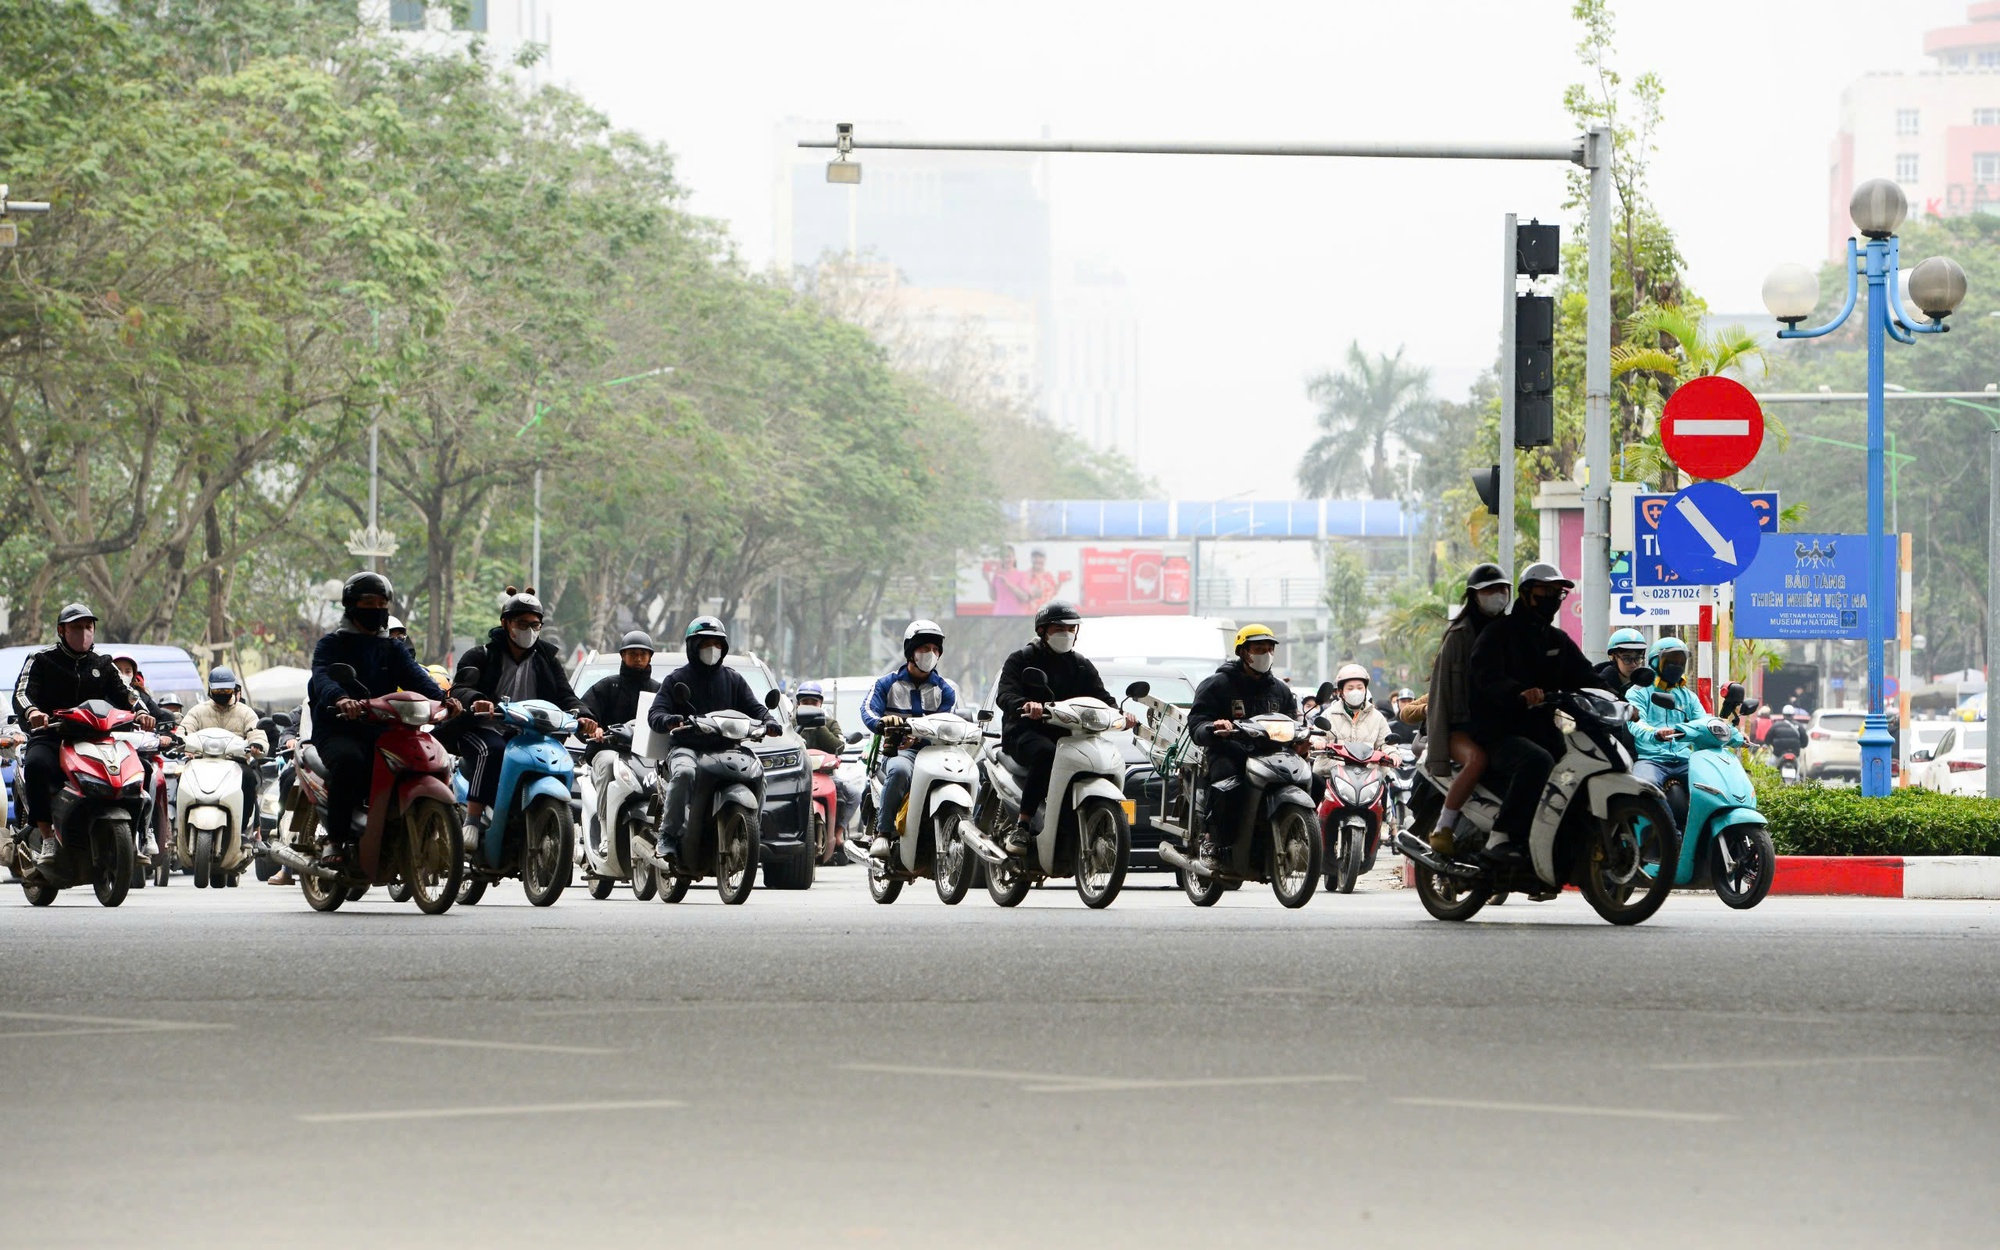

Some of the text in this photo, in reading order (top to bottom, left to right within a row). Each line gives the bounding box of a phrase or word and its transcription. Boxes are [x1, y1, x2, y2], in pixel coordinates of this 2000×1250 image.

[1785, 570, 1846, 589] BẢO TÀNG
[1653, 588, 1670, 599] 028
[1672, 588, 1694, 598] 7102
[1750, 590, 1868, 610] THIÊN NHIÊN VIỆT NA
[1650, 608, 1670, 616] 200m
[1770, 618, 1801, 626] MUSEUM
[1808, 618, 1839, 626] NATURE
